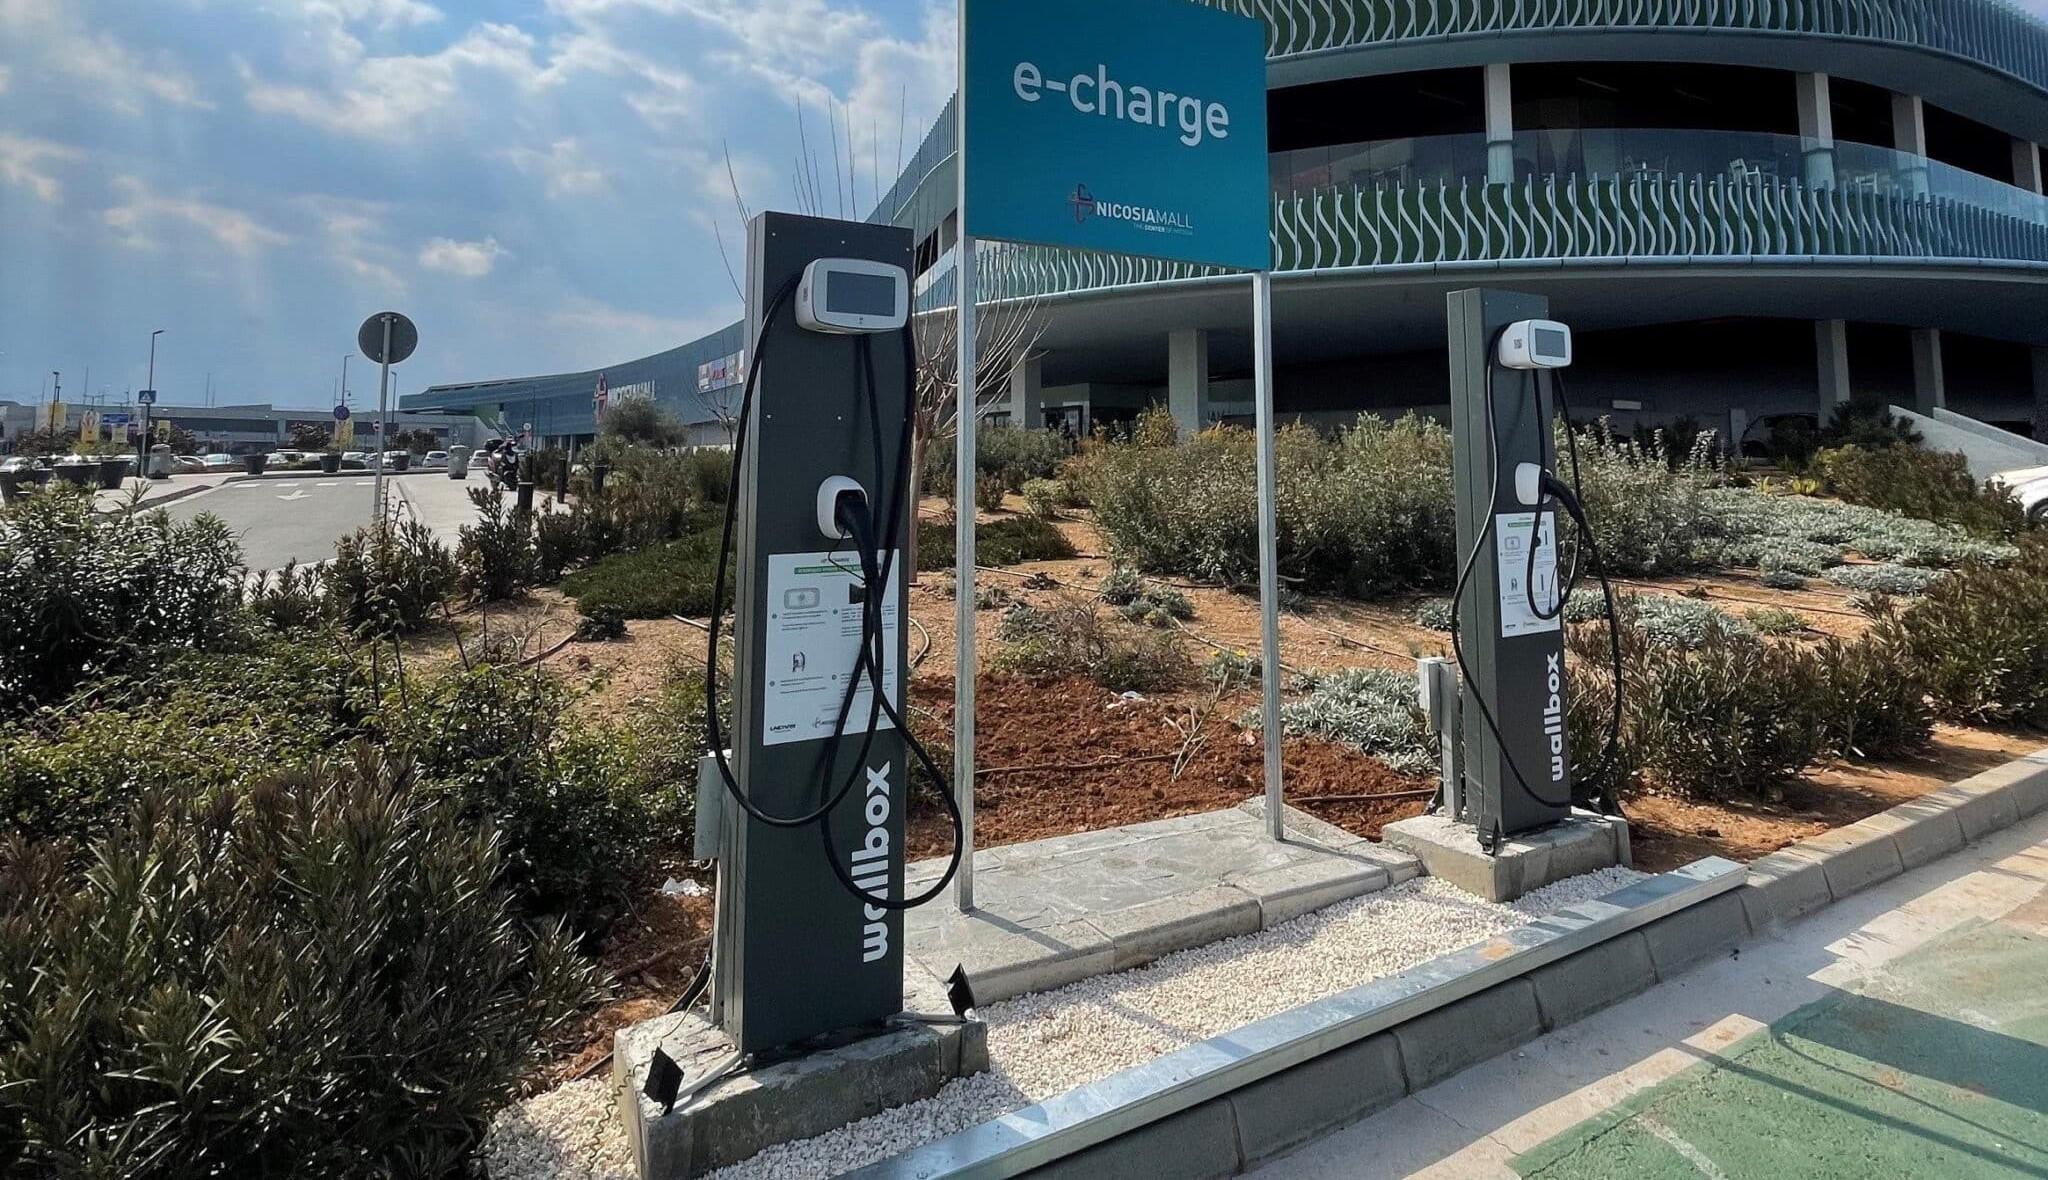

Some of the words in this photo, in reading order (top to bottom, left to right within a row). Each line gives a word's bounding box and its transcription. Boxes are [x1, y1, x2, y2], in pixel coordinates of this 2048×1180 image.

[1013, 61, 1230, 147] e-charge
[1543, 651, 1565, 783] wallbox
[850, 760, 890, 963] wallbox
